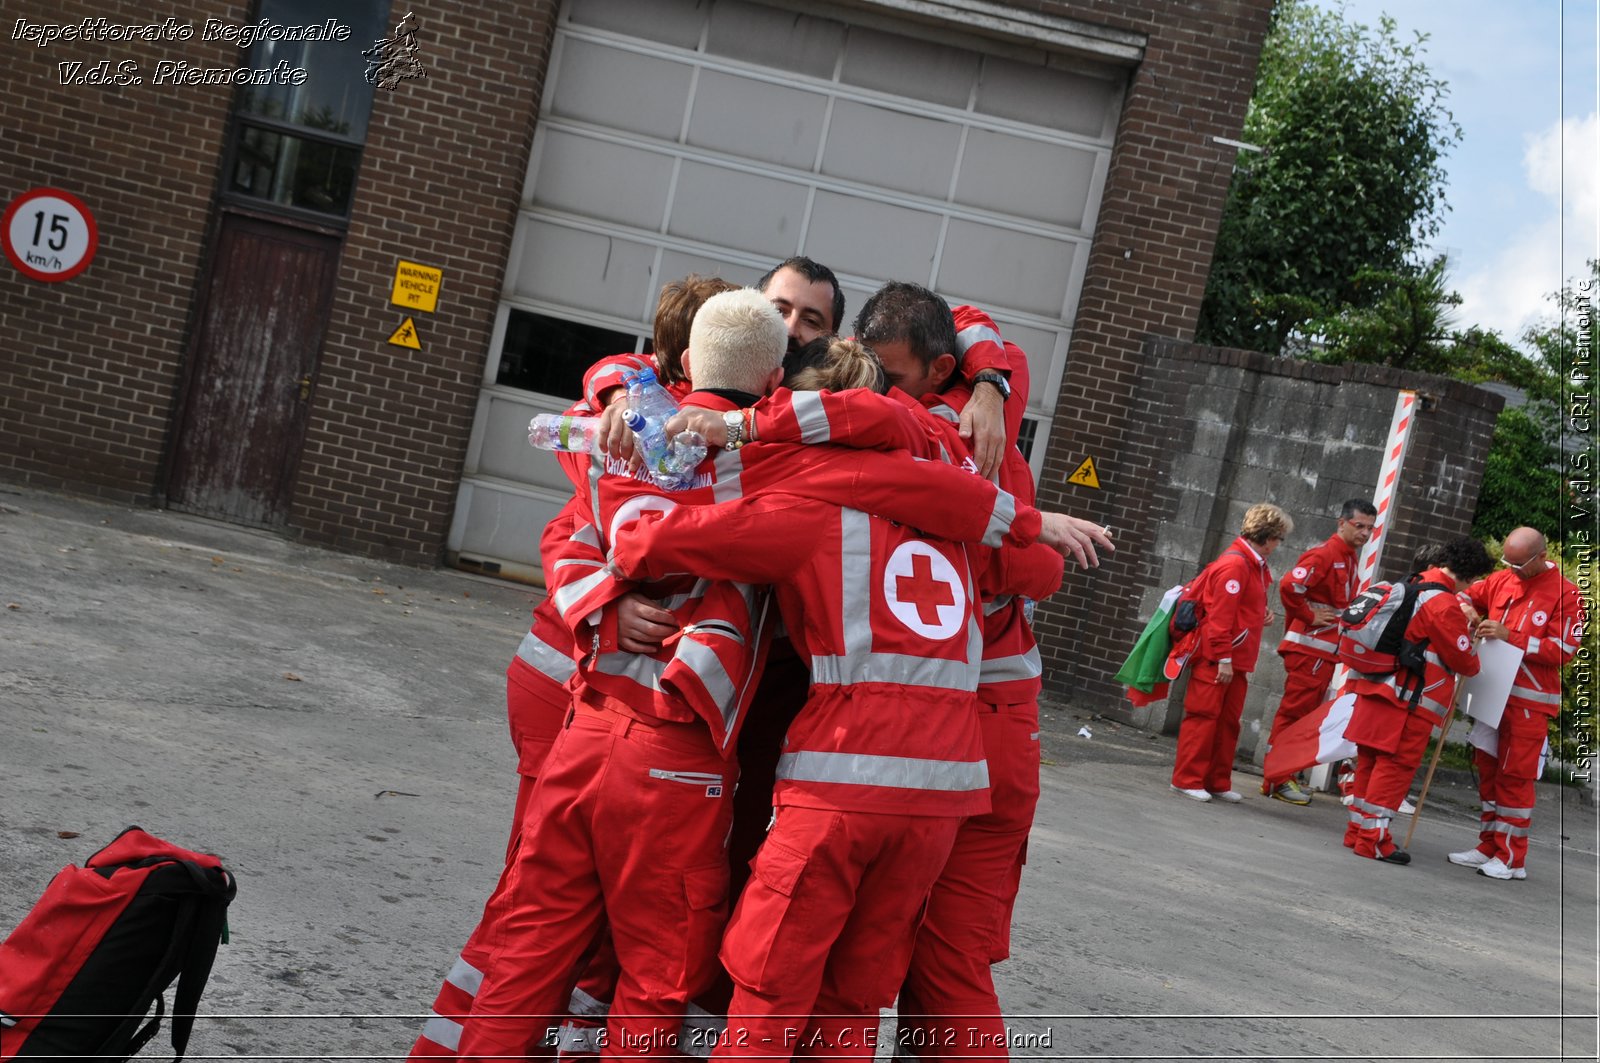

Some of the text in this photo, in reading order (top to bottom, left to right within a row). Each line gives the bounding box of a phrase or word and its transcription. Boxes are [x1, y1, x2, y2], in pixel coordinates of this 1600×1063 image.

[32, 210, 70, 252] 15
[26, 250, 62, 270] km/h
[400, 267, 439, 283] WARNING
[400, 279, 434, 294] VEHICLE
[407, 293, 420, 303] PIT
